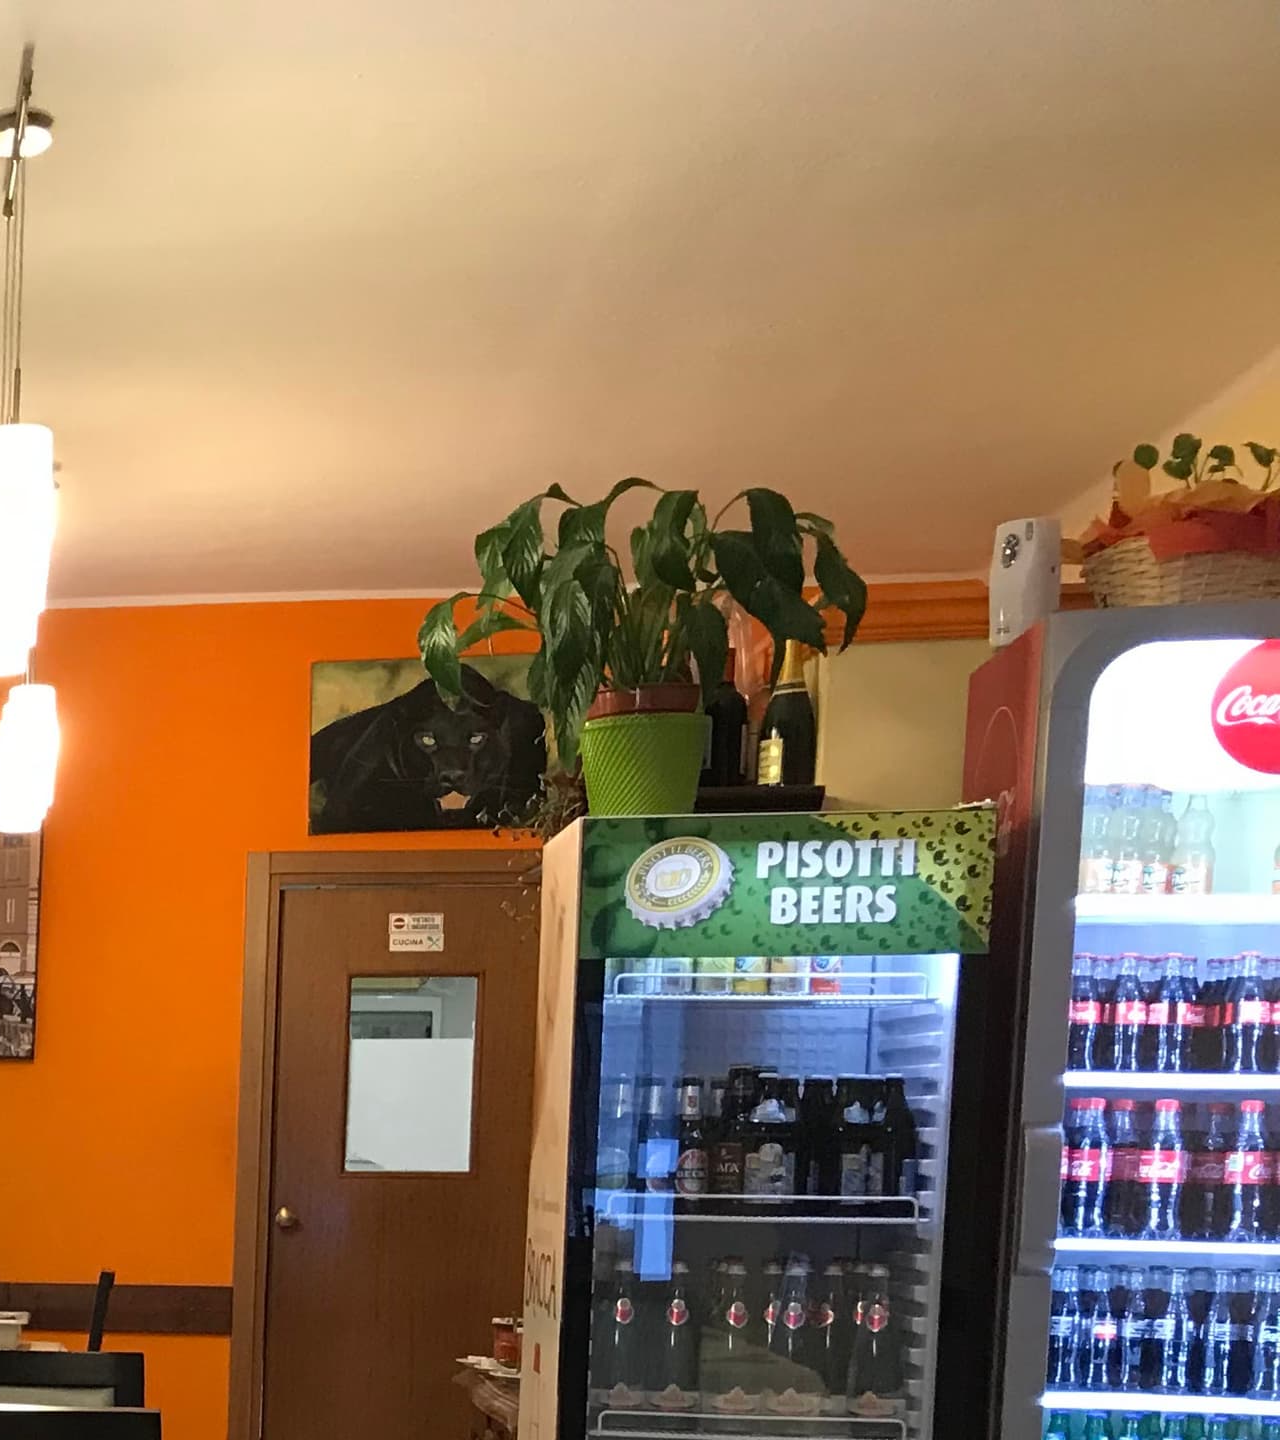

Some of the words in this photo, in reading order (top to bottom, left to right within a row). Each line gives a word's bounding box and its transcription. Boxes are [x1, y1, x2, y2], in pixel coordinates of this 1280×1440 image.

[756, 838, 917, 879] PISOTTI
[769, 885, 897, 925] BEERS
[392, 938, 424, 946] CUCINA
